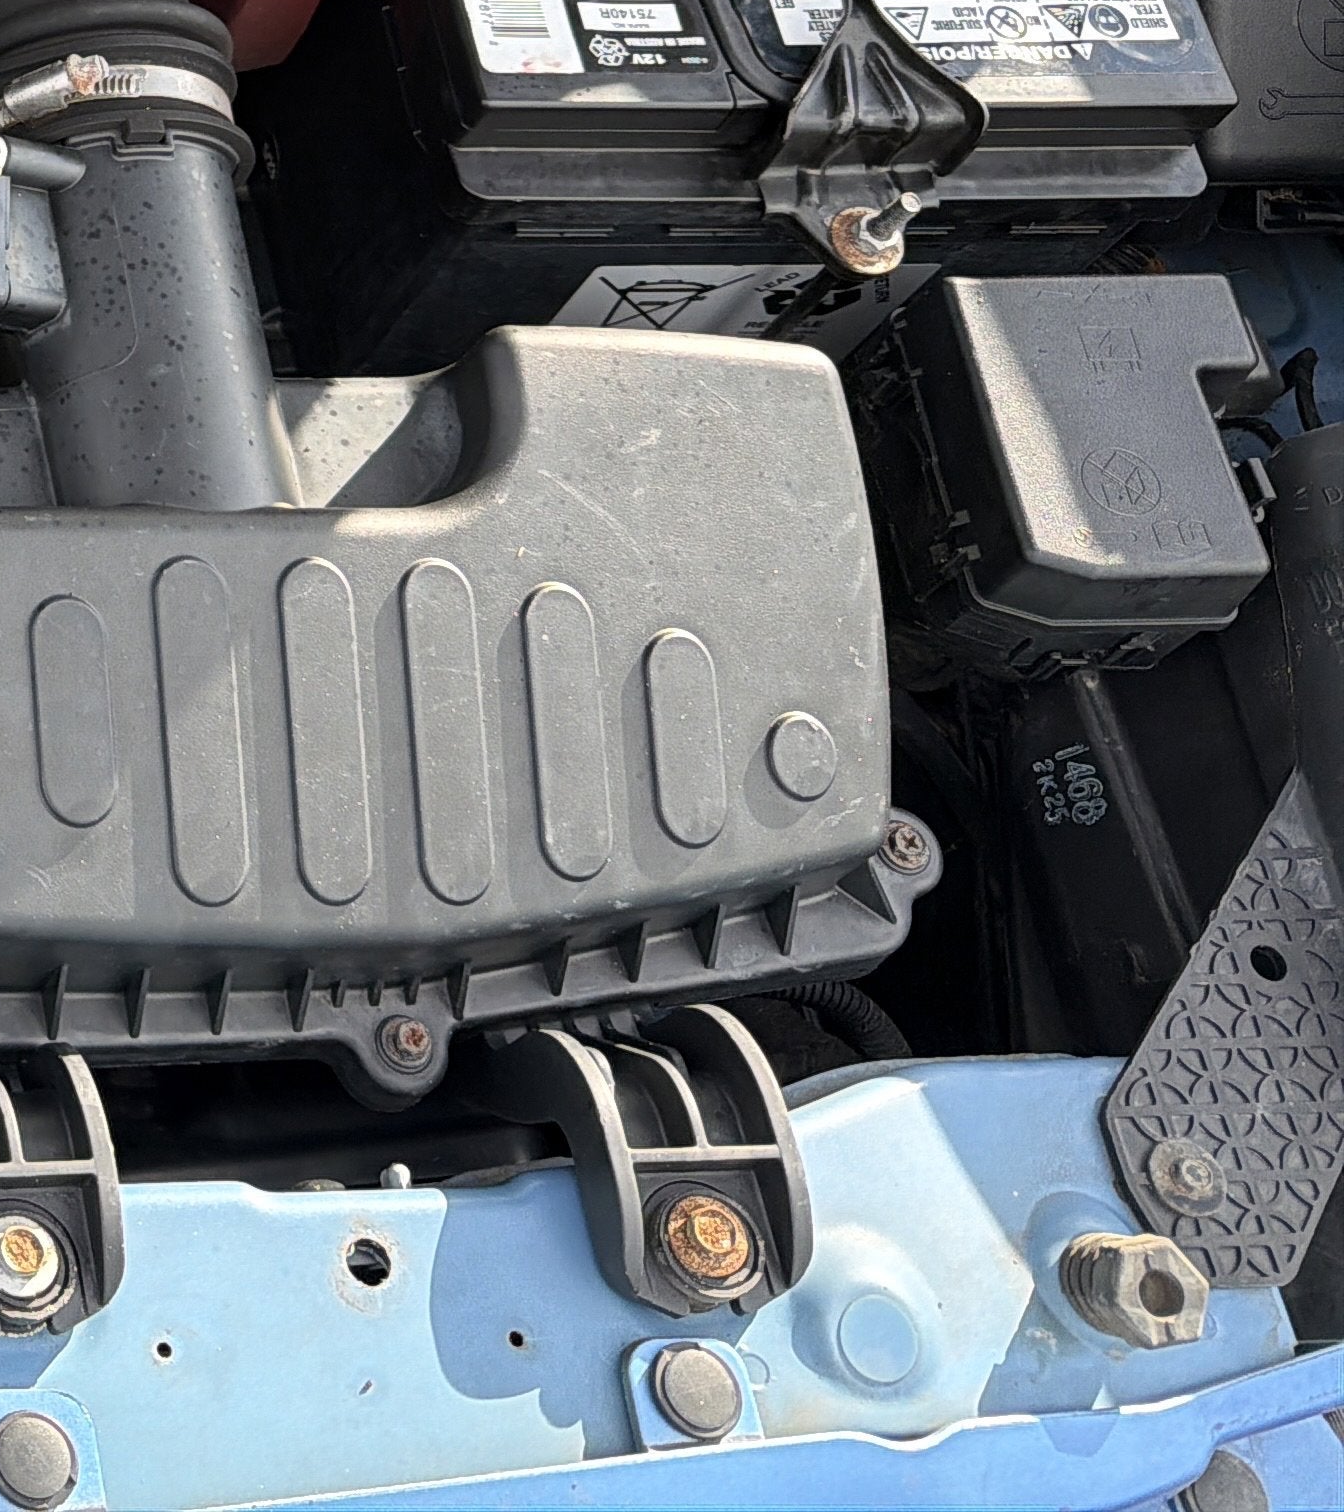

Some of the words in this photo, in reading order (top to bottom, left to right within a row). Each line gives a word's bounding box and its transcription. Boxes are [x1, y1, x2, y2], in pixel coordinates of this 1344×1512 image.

[774, 0, 794, 9] GET
[1129, 3, 1161, 15] EYES.
[599, 8, 657, 19] 75140R
[952, 6, 976, 17] ACID
[932, 19, 983, 31] SULFURIC
[1130, 17, 1169, 29] SHIELD
[910, 44, 1072, 60] DANGER/POIS
[630, 53, 667, 64] 12V
[754, 272, 801, 292] LEAD
[1055, 742, 1107, 825] 1468
